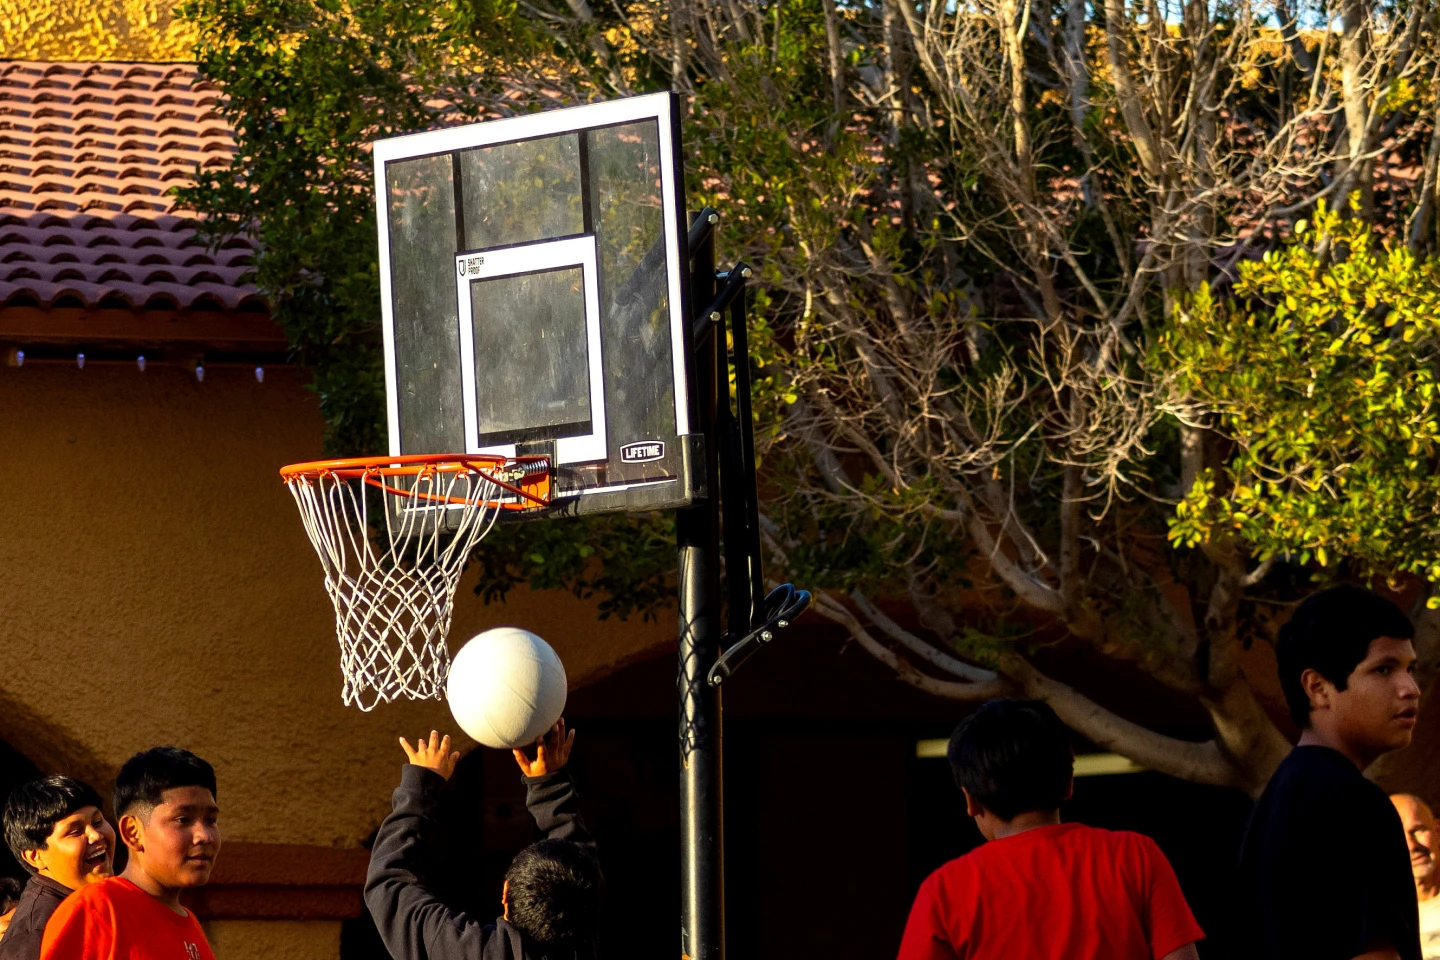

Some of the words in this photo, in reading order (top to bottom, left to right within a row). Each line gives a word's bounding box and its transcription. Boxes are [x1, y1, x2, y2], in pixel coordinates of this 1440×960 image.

[468, 257, 485, 267] SHATTER
[468, 266, 481, 275] PROOF
[625, 445, 660, 459] LIFETIME
